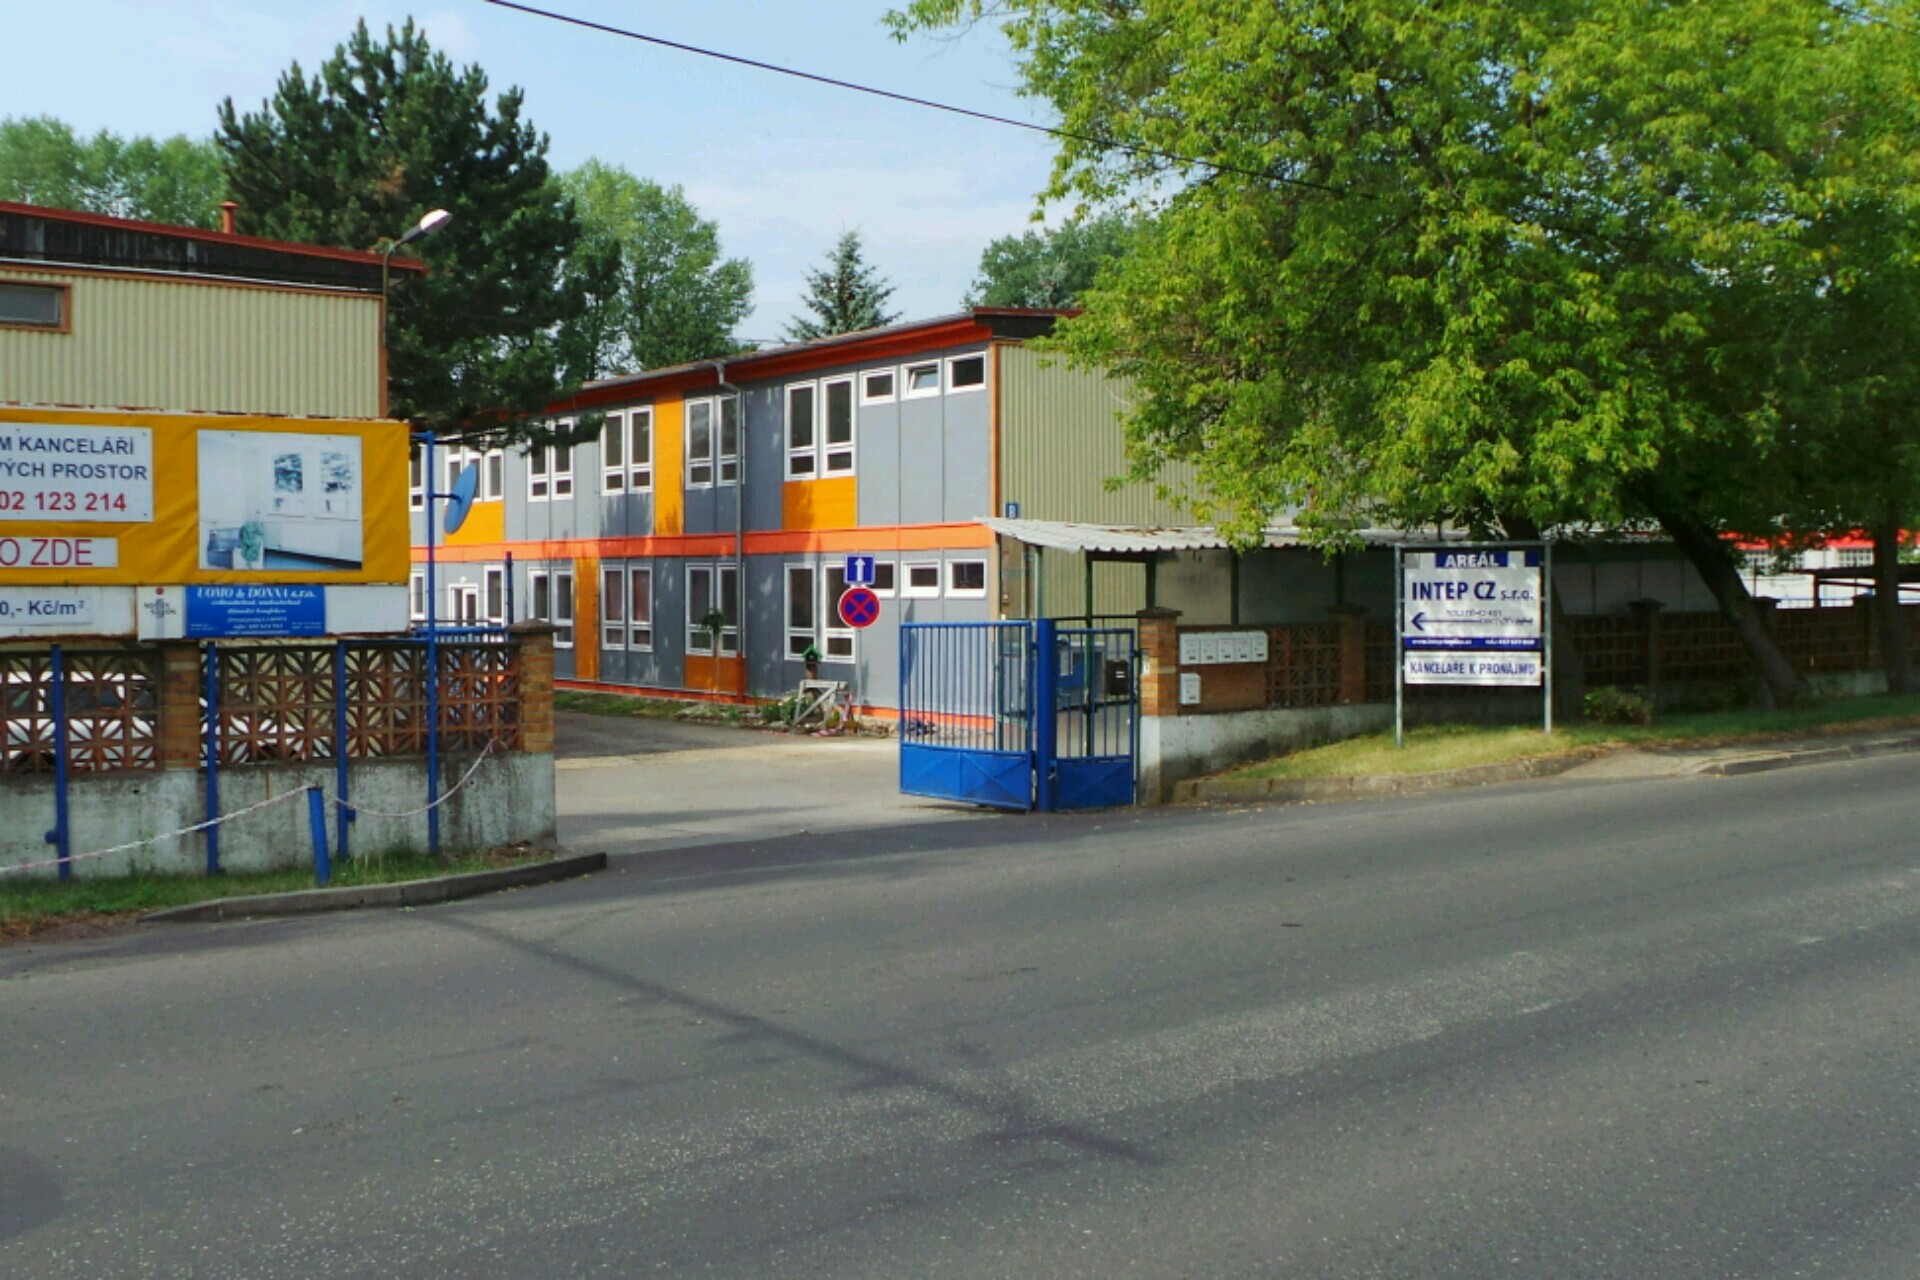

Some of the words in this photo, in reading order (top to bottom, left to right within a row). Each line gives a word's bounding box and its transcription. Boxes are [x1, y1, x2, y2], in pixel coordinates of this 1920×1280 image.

[19, 436, 134, 455] KANCELÁŘÍ
[52, 463, 147, 480] PROSTOR
[35, 491, 76, 511] 123
[85, 492, 127, 512] 214
[31, 538, 93, 566] ZDE
[1445, 552, 1499, 568] AREÁL
[1412, 582, 1468, 601] INTEP
[1473, 582, 1496, 601] CZ
[1469, 663, 1476, 674] K
